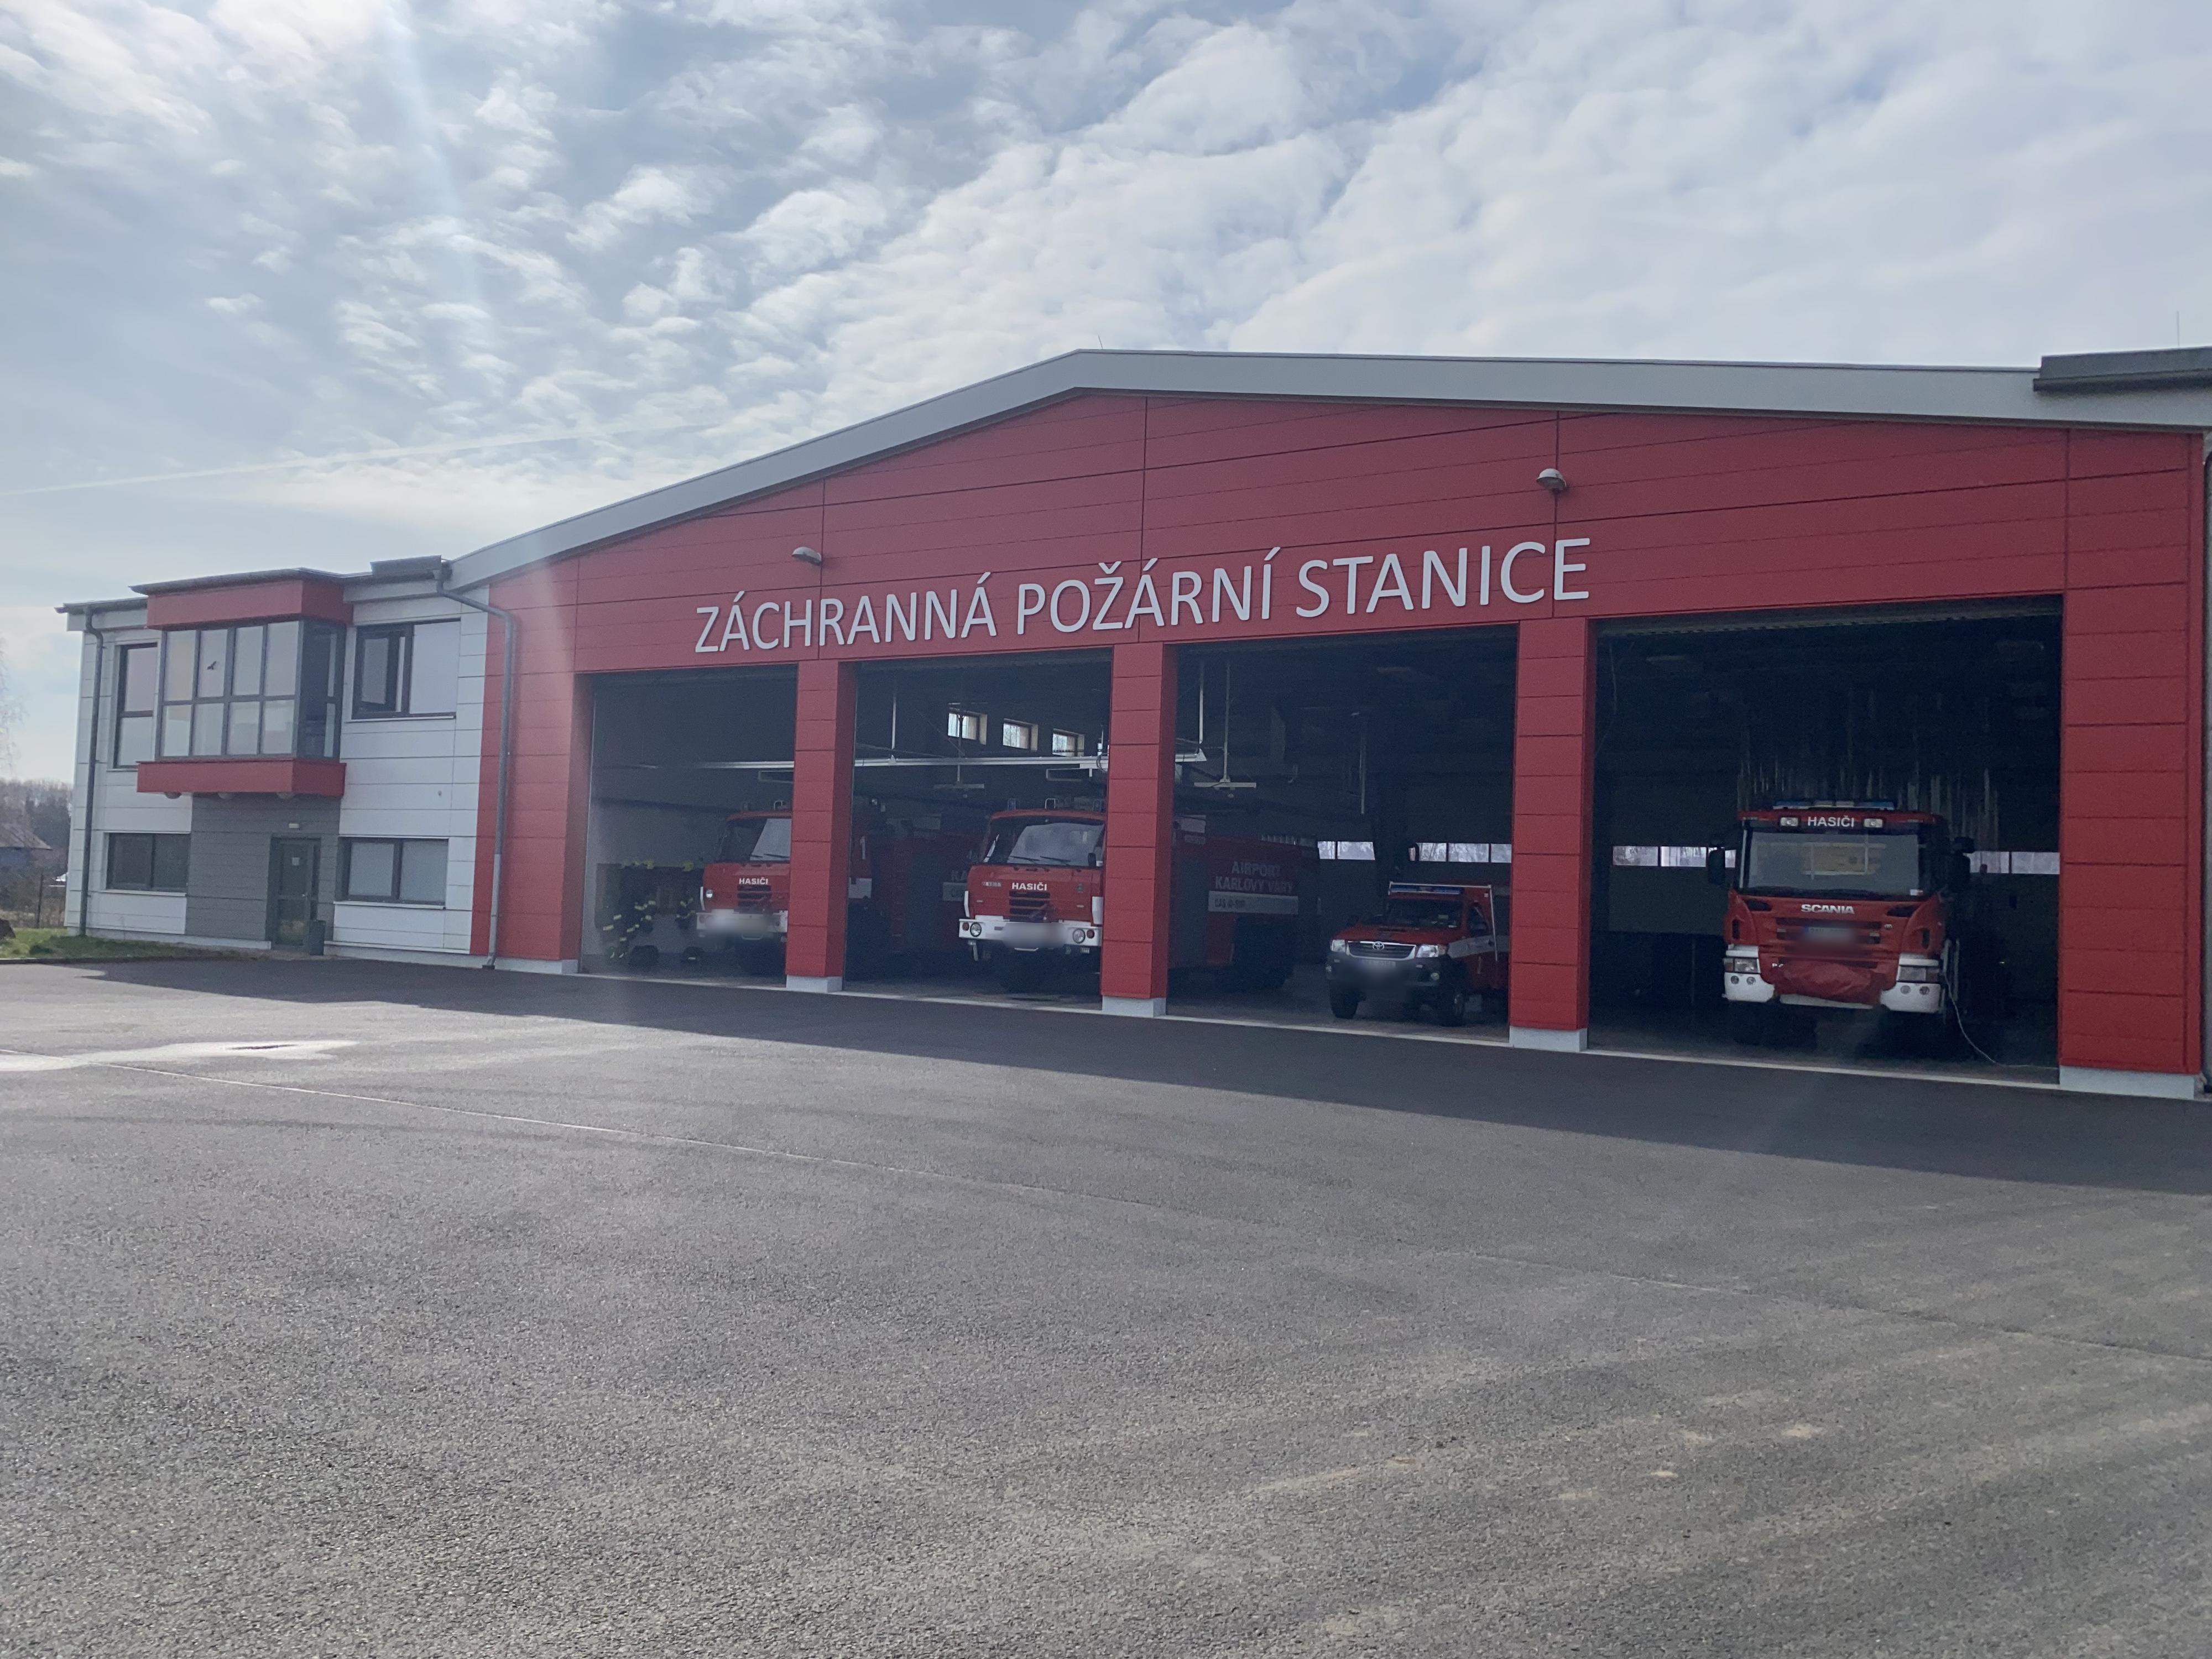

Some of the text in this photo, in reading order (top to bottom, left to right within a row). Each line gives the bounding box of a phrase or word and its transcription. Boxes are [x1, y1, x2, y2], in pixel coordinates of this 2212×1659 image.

[695, 537, 1590, 653] ZÁCHRANNÁ POŽÁRNÍ STANICE
[1807, 815, 1855, 828] HASIČI
[1232, 861, 1281, 877] AIRPORT
[739, 877, 769, 885] HASIČI
[1011, 881, 1047, 891] HASIČI
[1215, 876, 1293, 894] KARLOVY VARY
[1801, 904, 1855, 915] SCANIA
